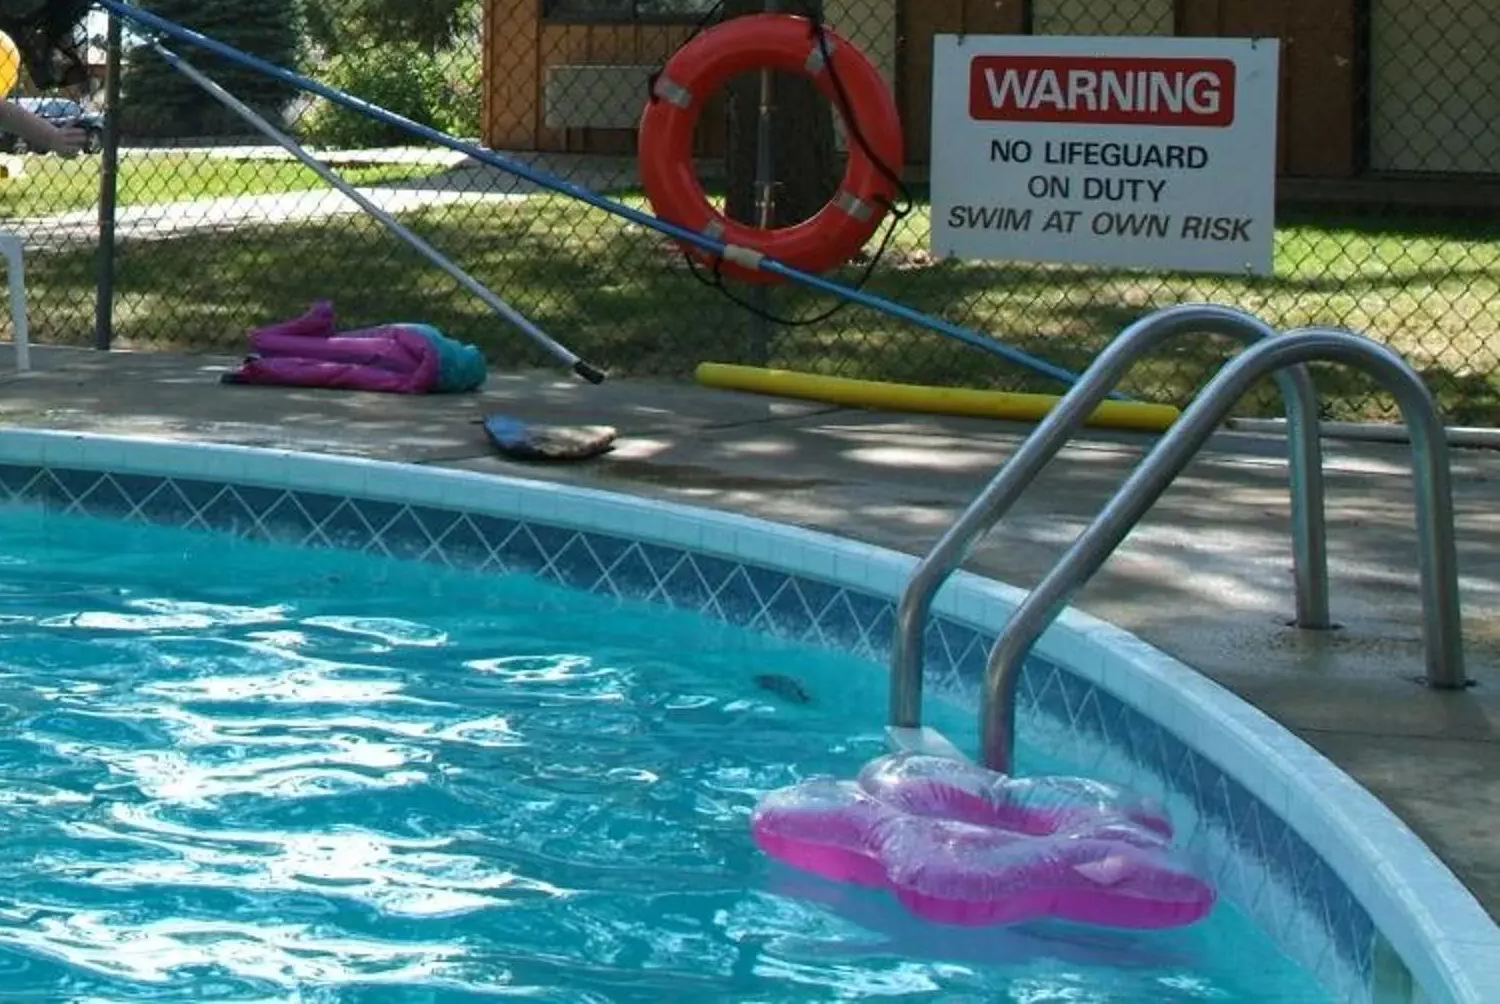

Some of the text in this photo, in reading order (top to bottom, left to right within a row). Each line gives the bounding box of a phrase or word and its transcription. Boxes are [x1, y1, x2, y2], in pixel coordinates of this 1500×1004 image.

[984, 67, 1222, 115] WARNING
[990, 139, 1208, 170] NO LIFEGUARD
[1027, 175, 1167, 204] ON DUTY
[947, 205, 1255, 244] SWIM AT OWN RISK
